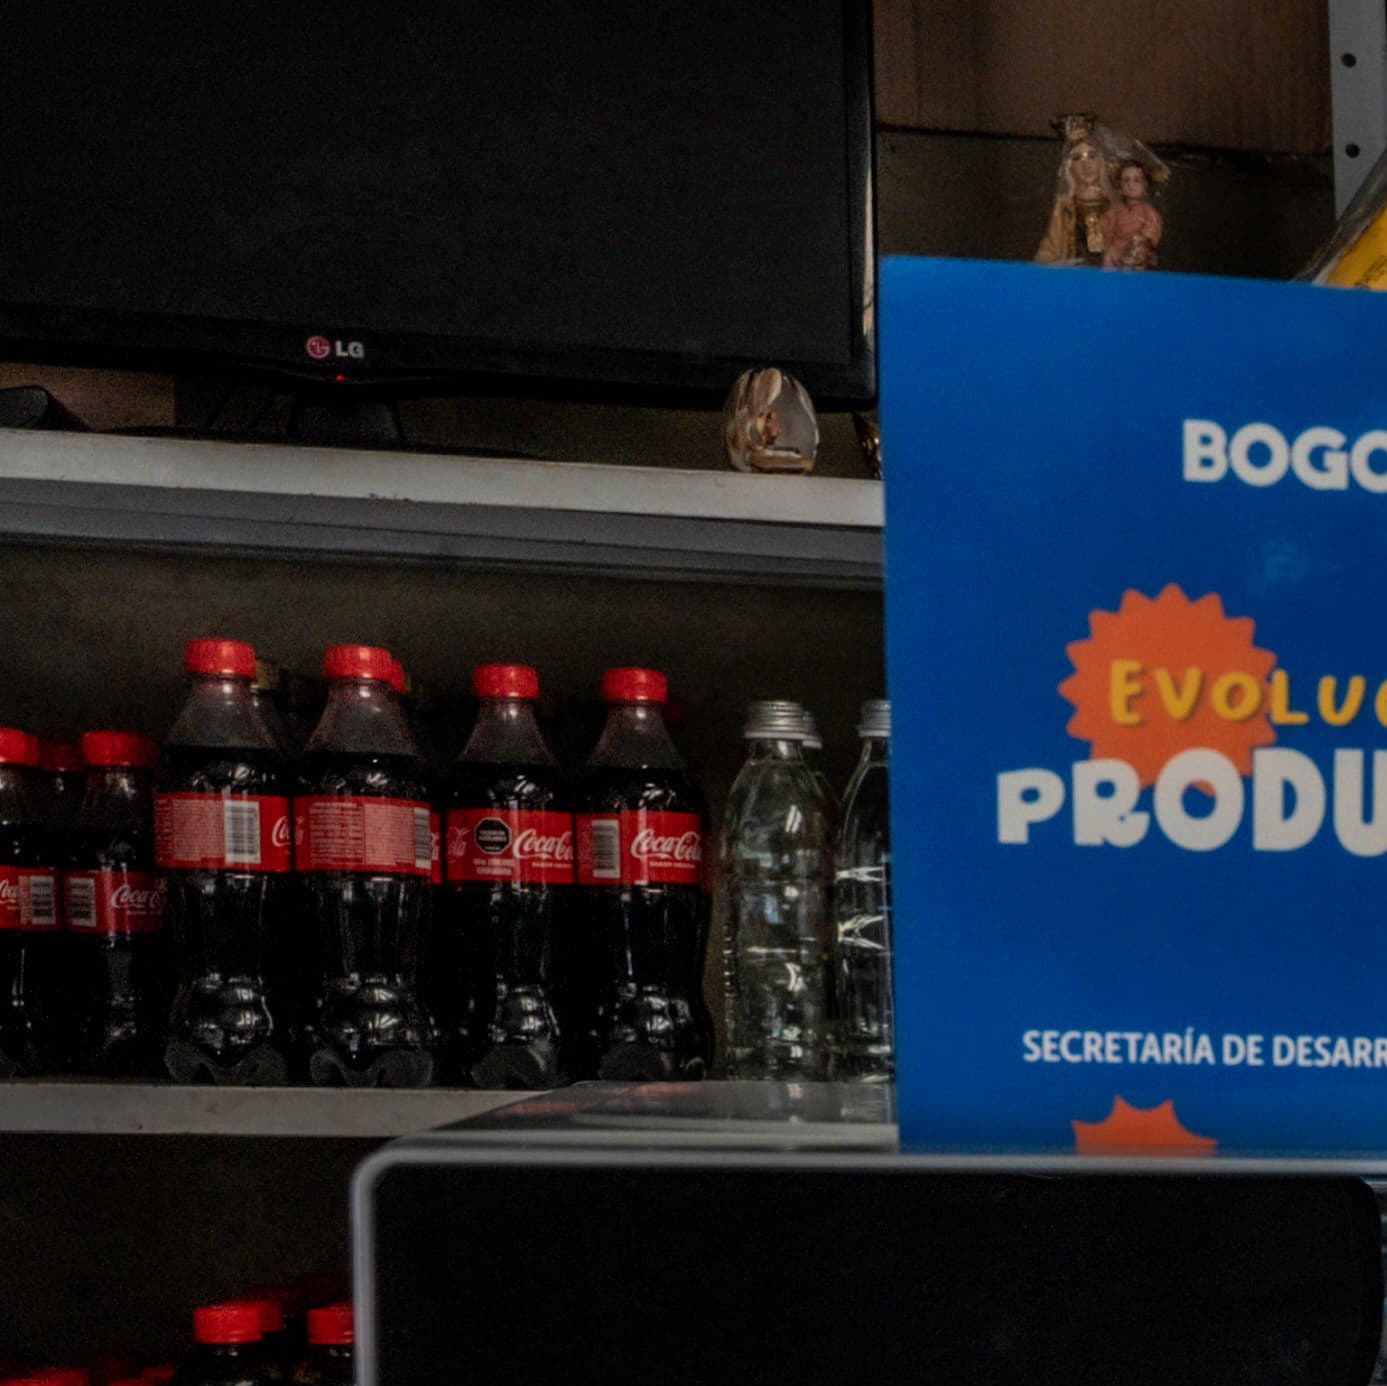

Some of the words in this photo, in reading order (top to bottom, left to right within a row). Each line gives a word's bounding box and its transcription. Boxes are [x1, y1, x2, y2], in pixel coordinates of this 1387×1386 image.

[335, 340, 365, 360] LG
[1023, 1027, 1214, 1066] SECRETARÍA
[1222, 1034, 1264, 1066] DE
